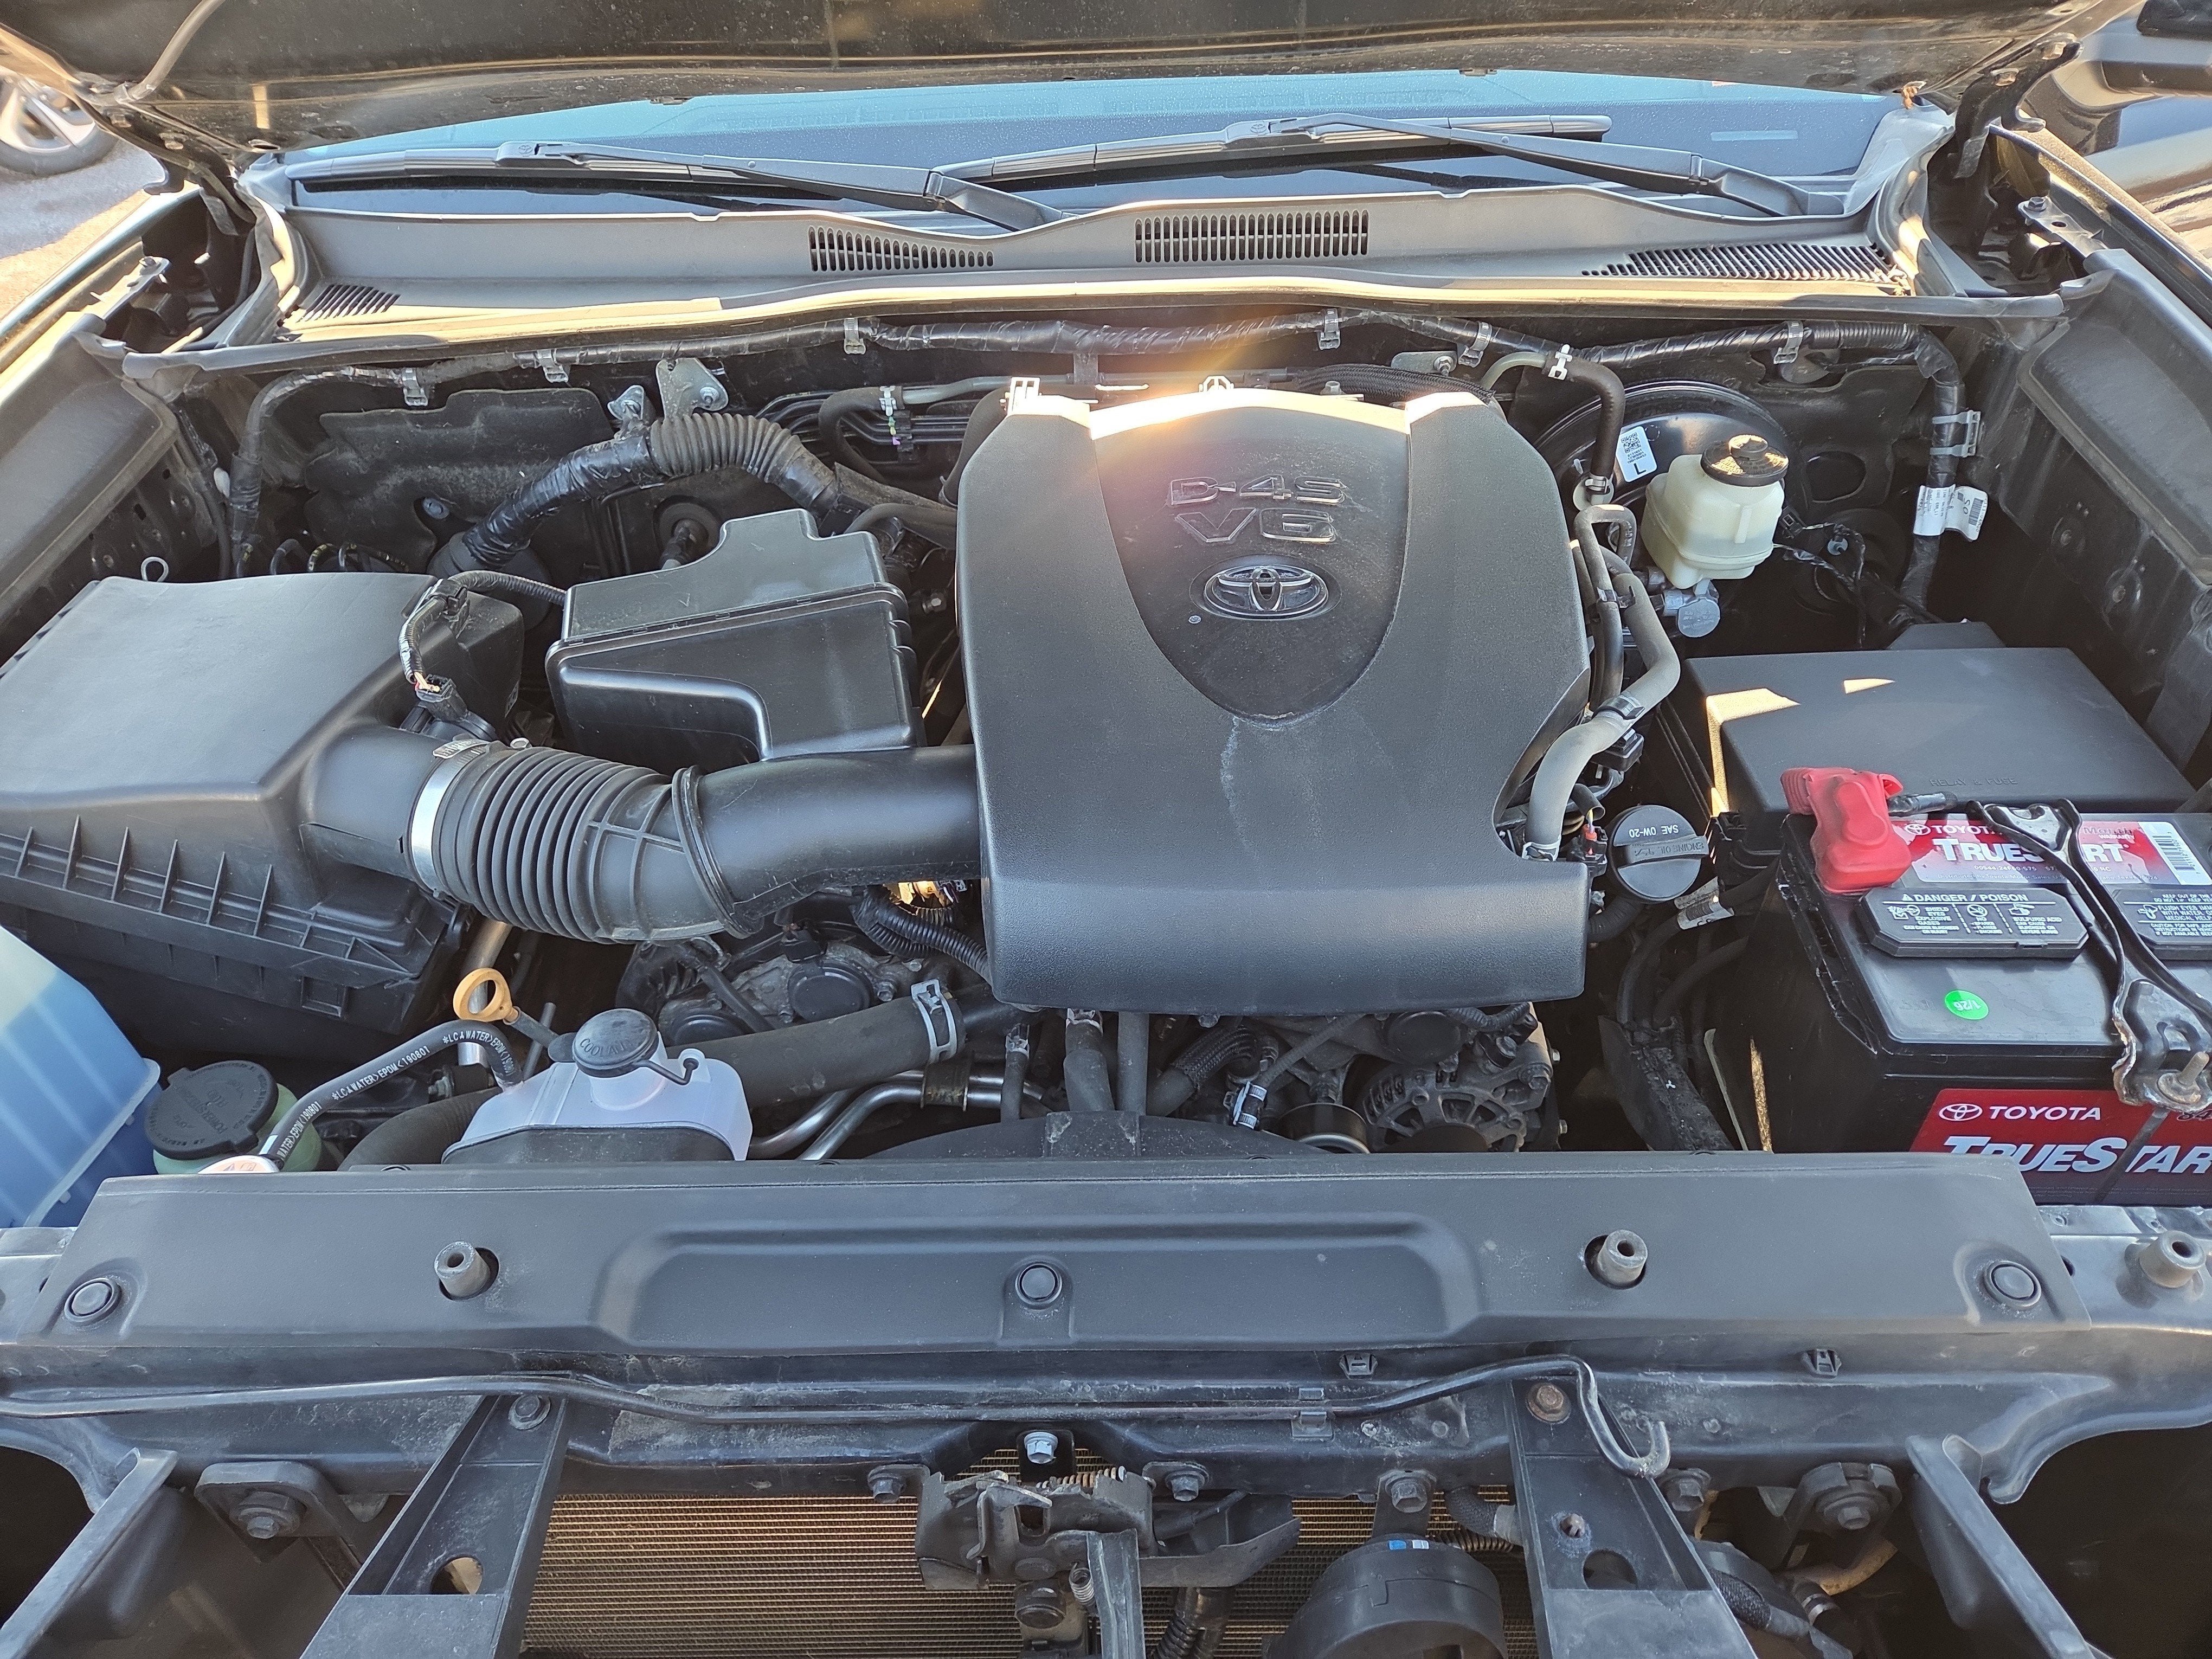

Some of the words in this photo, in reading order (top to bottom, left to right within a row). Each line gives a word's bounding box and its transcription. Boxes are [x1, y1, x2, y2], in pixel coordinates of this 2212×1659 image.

[1634, 463, 1647, 475] L
[1171, 474, 1347, 505] D-4S
[1175, 507, 1335, 543] V6
[1629, 826, 1657, 838] 0W-20
[1662, 824, 1679, 834] SAE
[1931, 825, 2002, 835] TOYOT
[1953, 999, 1982, 1011] 1/26
[580, 1038, 632, 1057] COOLA
[1989, 1106, 2101, 1121] TOYOTA
